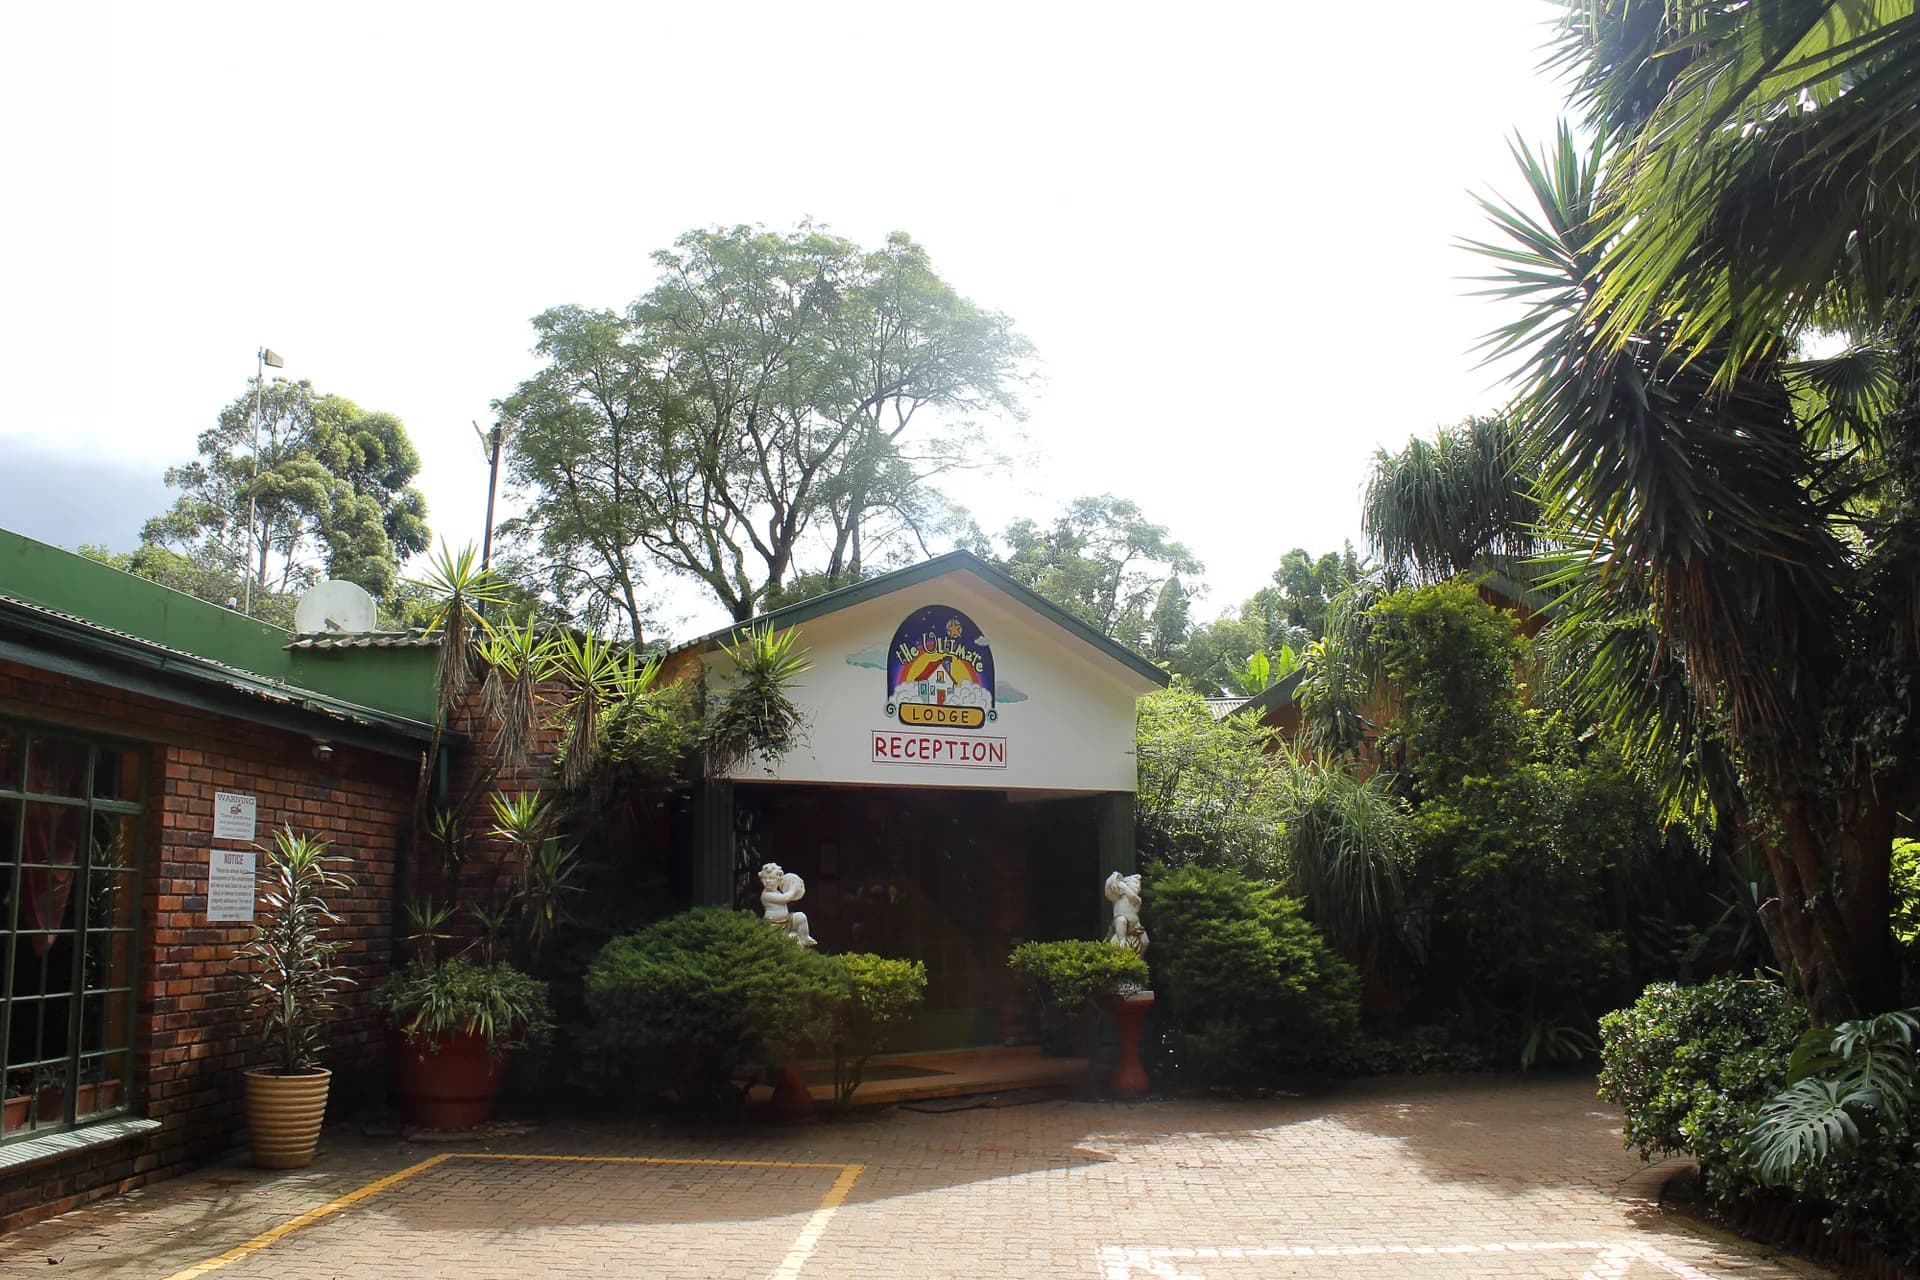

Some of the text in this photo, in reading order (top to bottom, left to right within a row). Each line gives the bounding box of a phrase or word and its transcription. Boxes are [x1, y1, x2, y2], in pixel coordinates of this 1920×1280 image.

[912, 708, 969, 724] LODGE
[875, 737, 1003, 763] RECEPTION
[217, 794, 255, 805] WARNING
[224, 853, 244, 865] NOTICE
